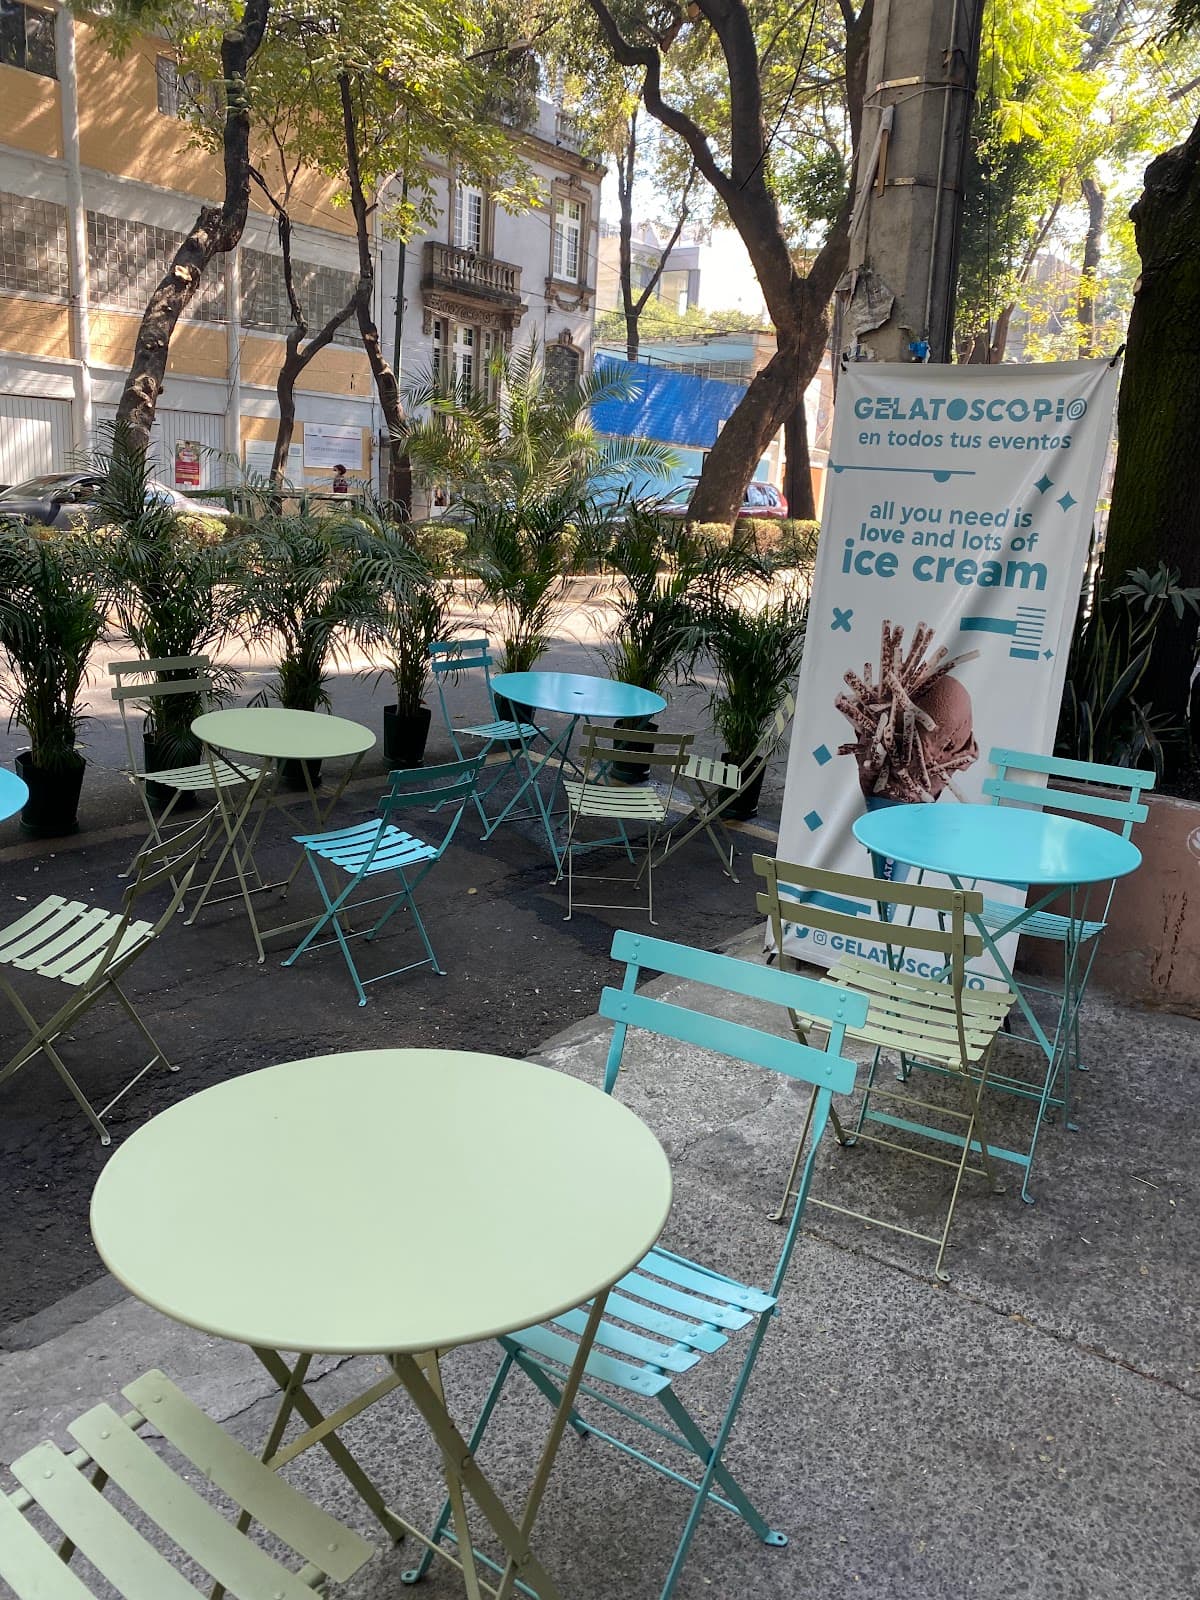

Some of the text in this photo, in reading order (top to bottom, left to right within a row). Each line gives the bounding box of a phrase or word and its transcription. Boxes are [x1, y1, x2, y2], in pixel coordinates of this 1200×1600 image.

[858, 430, 1072, 450] en todos tus eventos
[869, 501, 1033, 528] all you need is
[860, 523, 1040, 552] love and lots of
[841, 538, 1048, 591] ice cream
